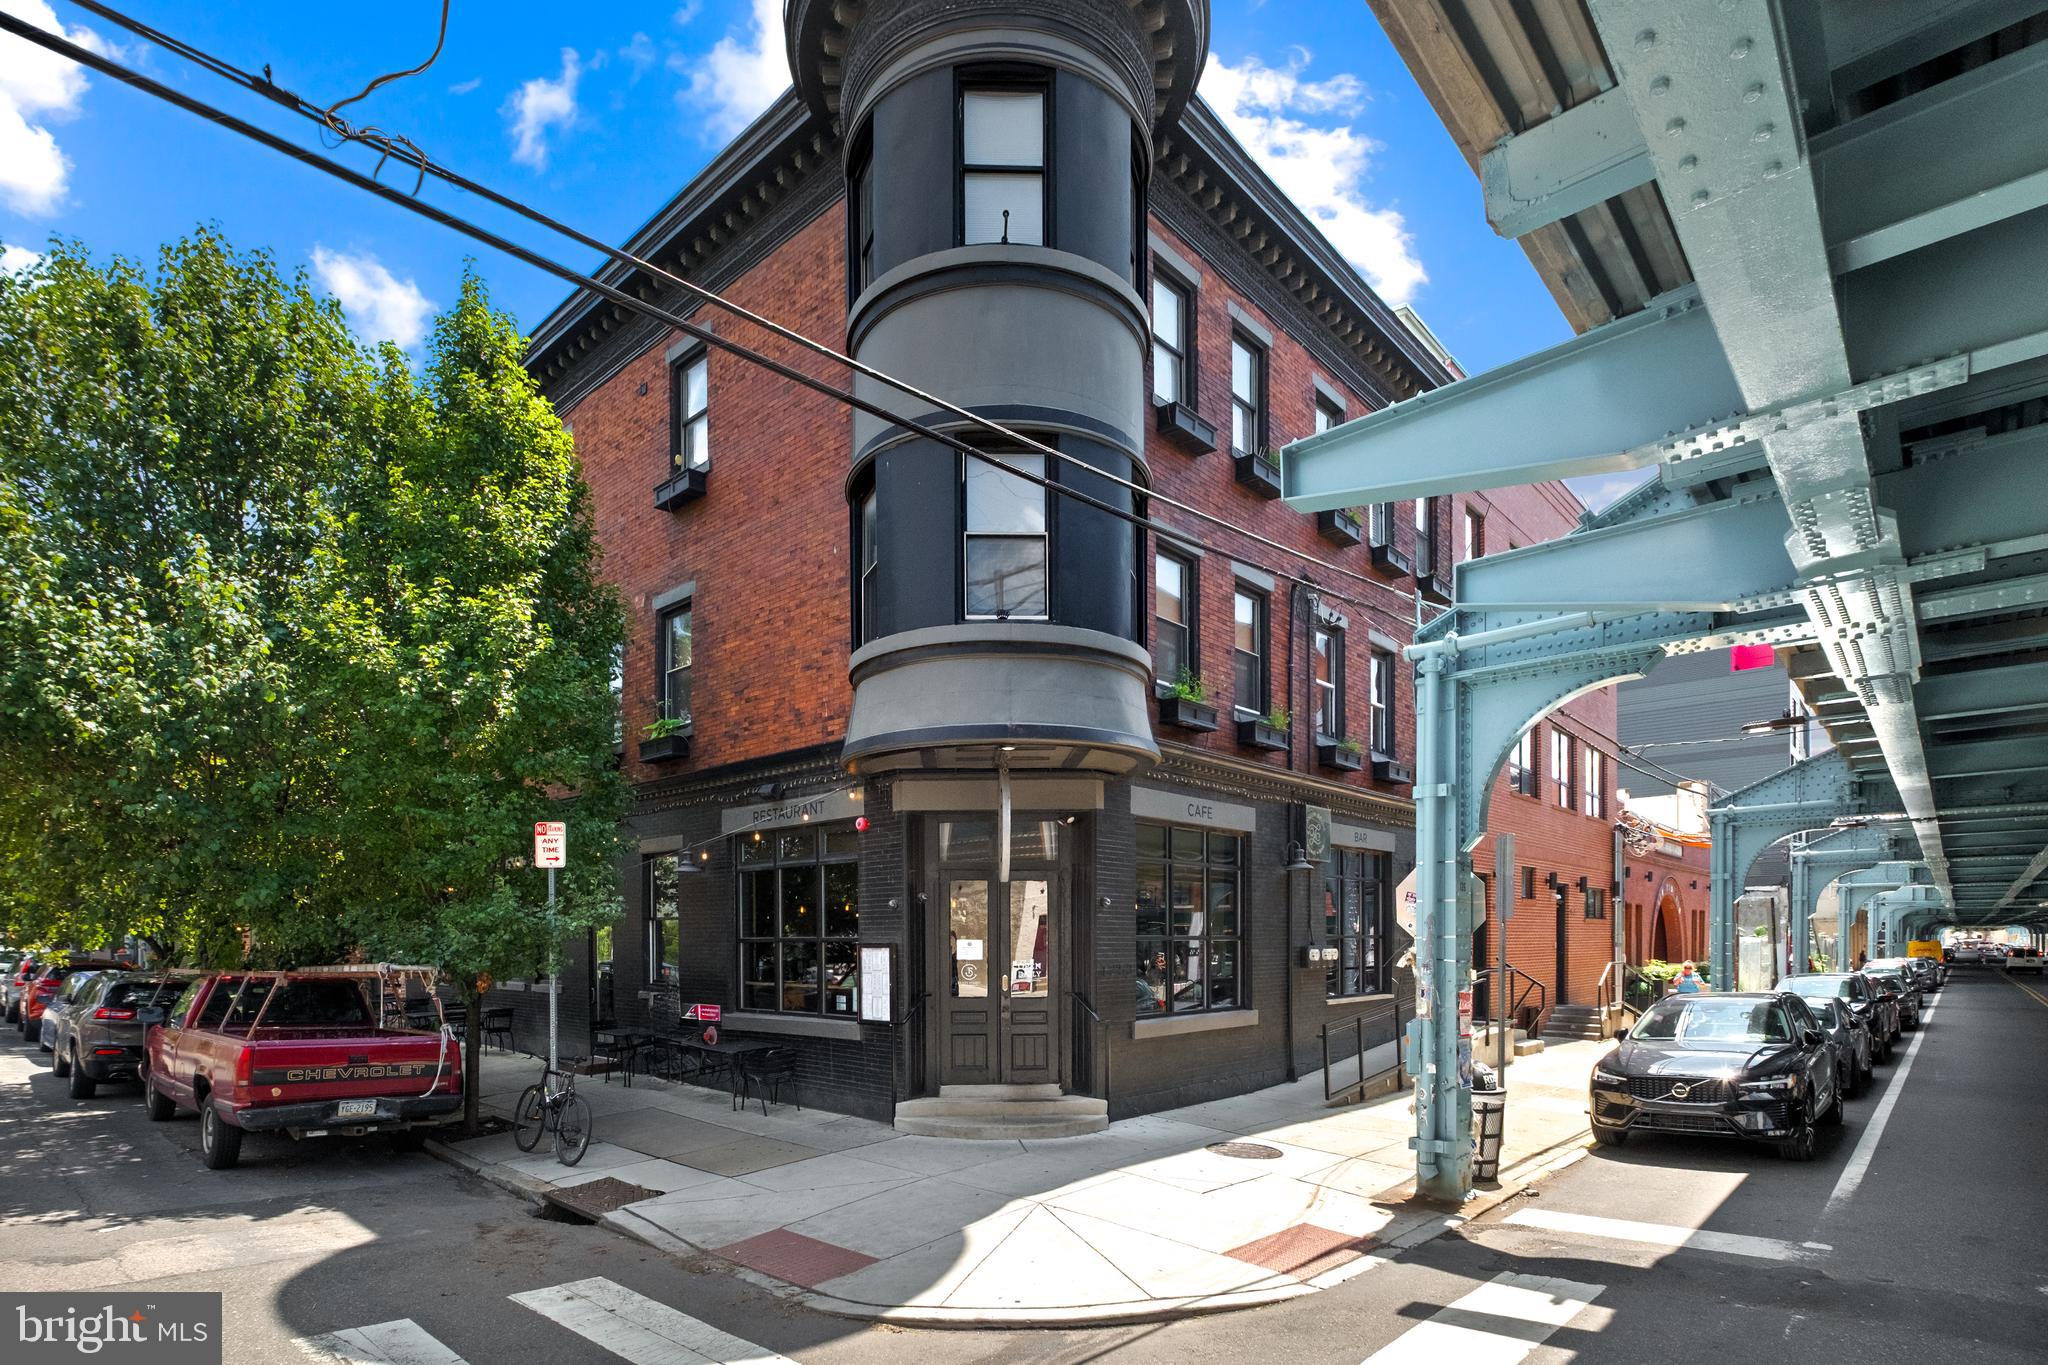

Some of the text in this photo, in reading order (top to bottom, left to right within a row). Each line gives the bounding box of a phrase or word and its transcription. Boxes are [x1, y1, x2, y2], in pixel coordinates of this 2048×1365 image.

[752, 800, 825, 823] RESTAURANT
[1187, 803, 1213, 820] CAFE
[536, 824, 546, 834] NO
[1354, 832, 1368, 843] BAR
[287, 1064, 426, 1081] CHEVROLET
